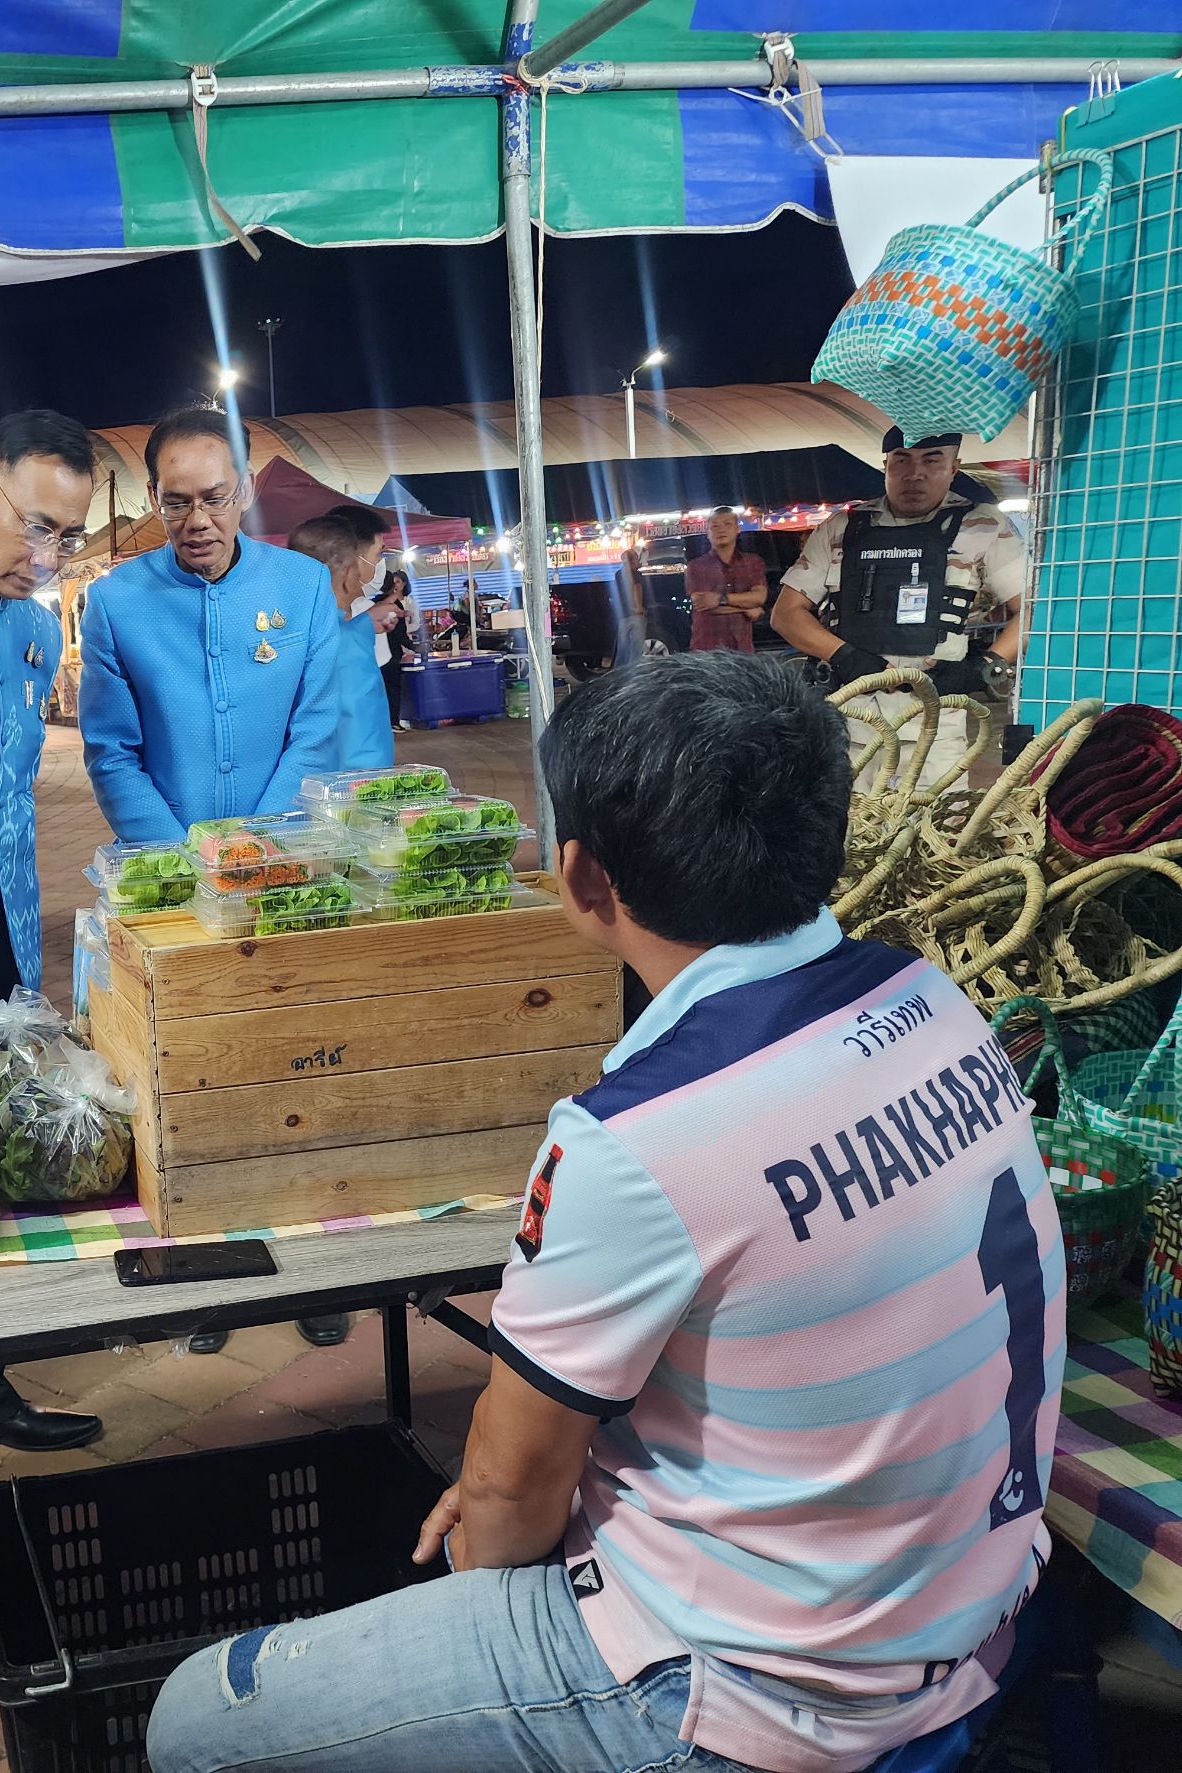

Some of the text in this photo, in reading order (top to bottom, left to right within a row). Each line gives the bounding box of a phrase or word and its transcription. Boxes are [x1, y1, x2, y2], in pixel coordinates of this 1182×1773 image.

[860, 546, 923, 560] กรมการปกครอง
[843, 993, 933, 1058] วารีเทพ
[764, 1034, 1026, 1242] PHAKHAPH
[977, 1166, 1045, 1532] 1
